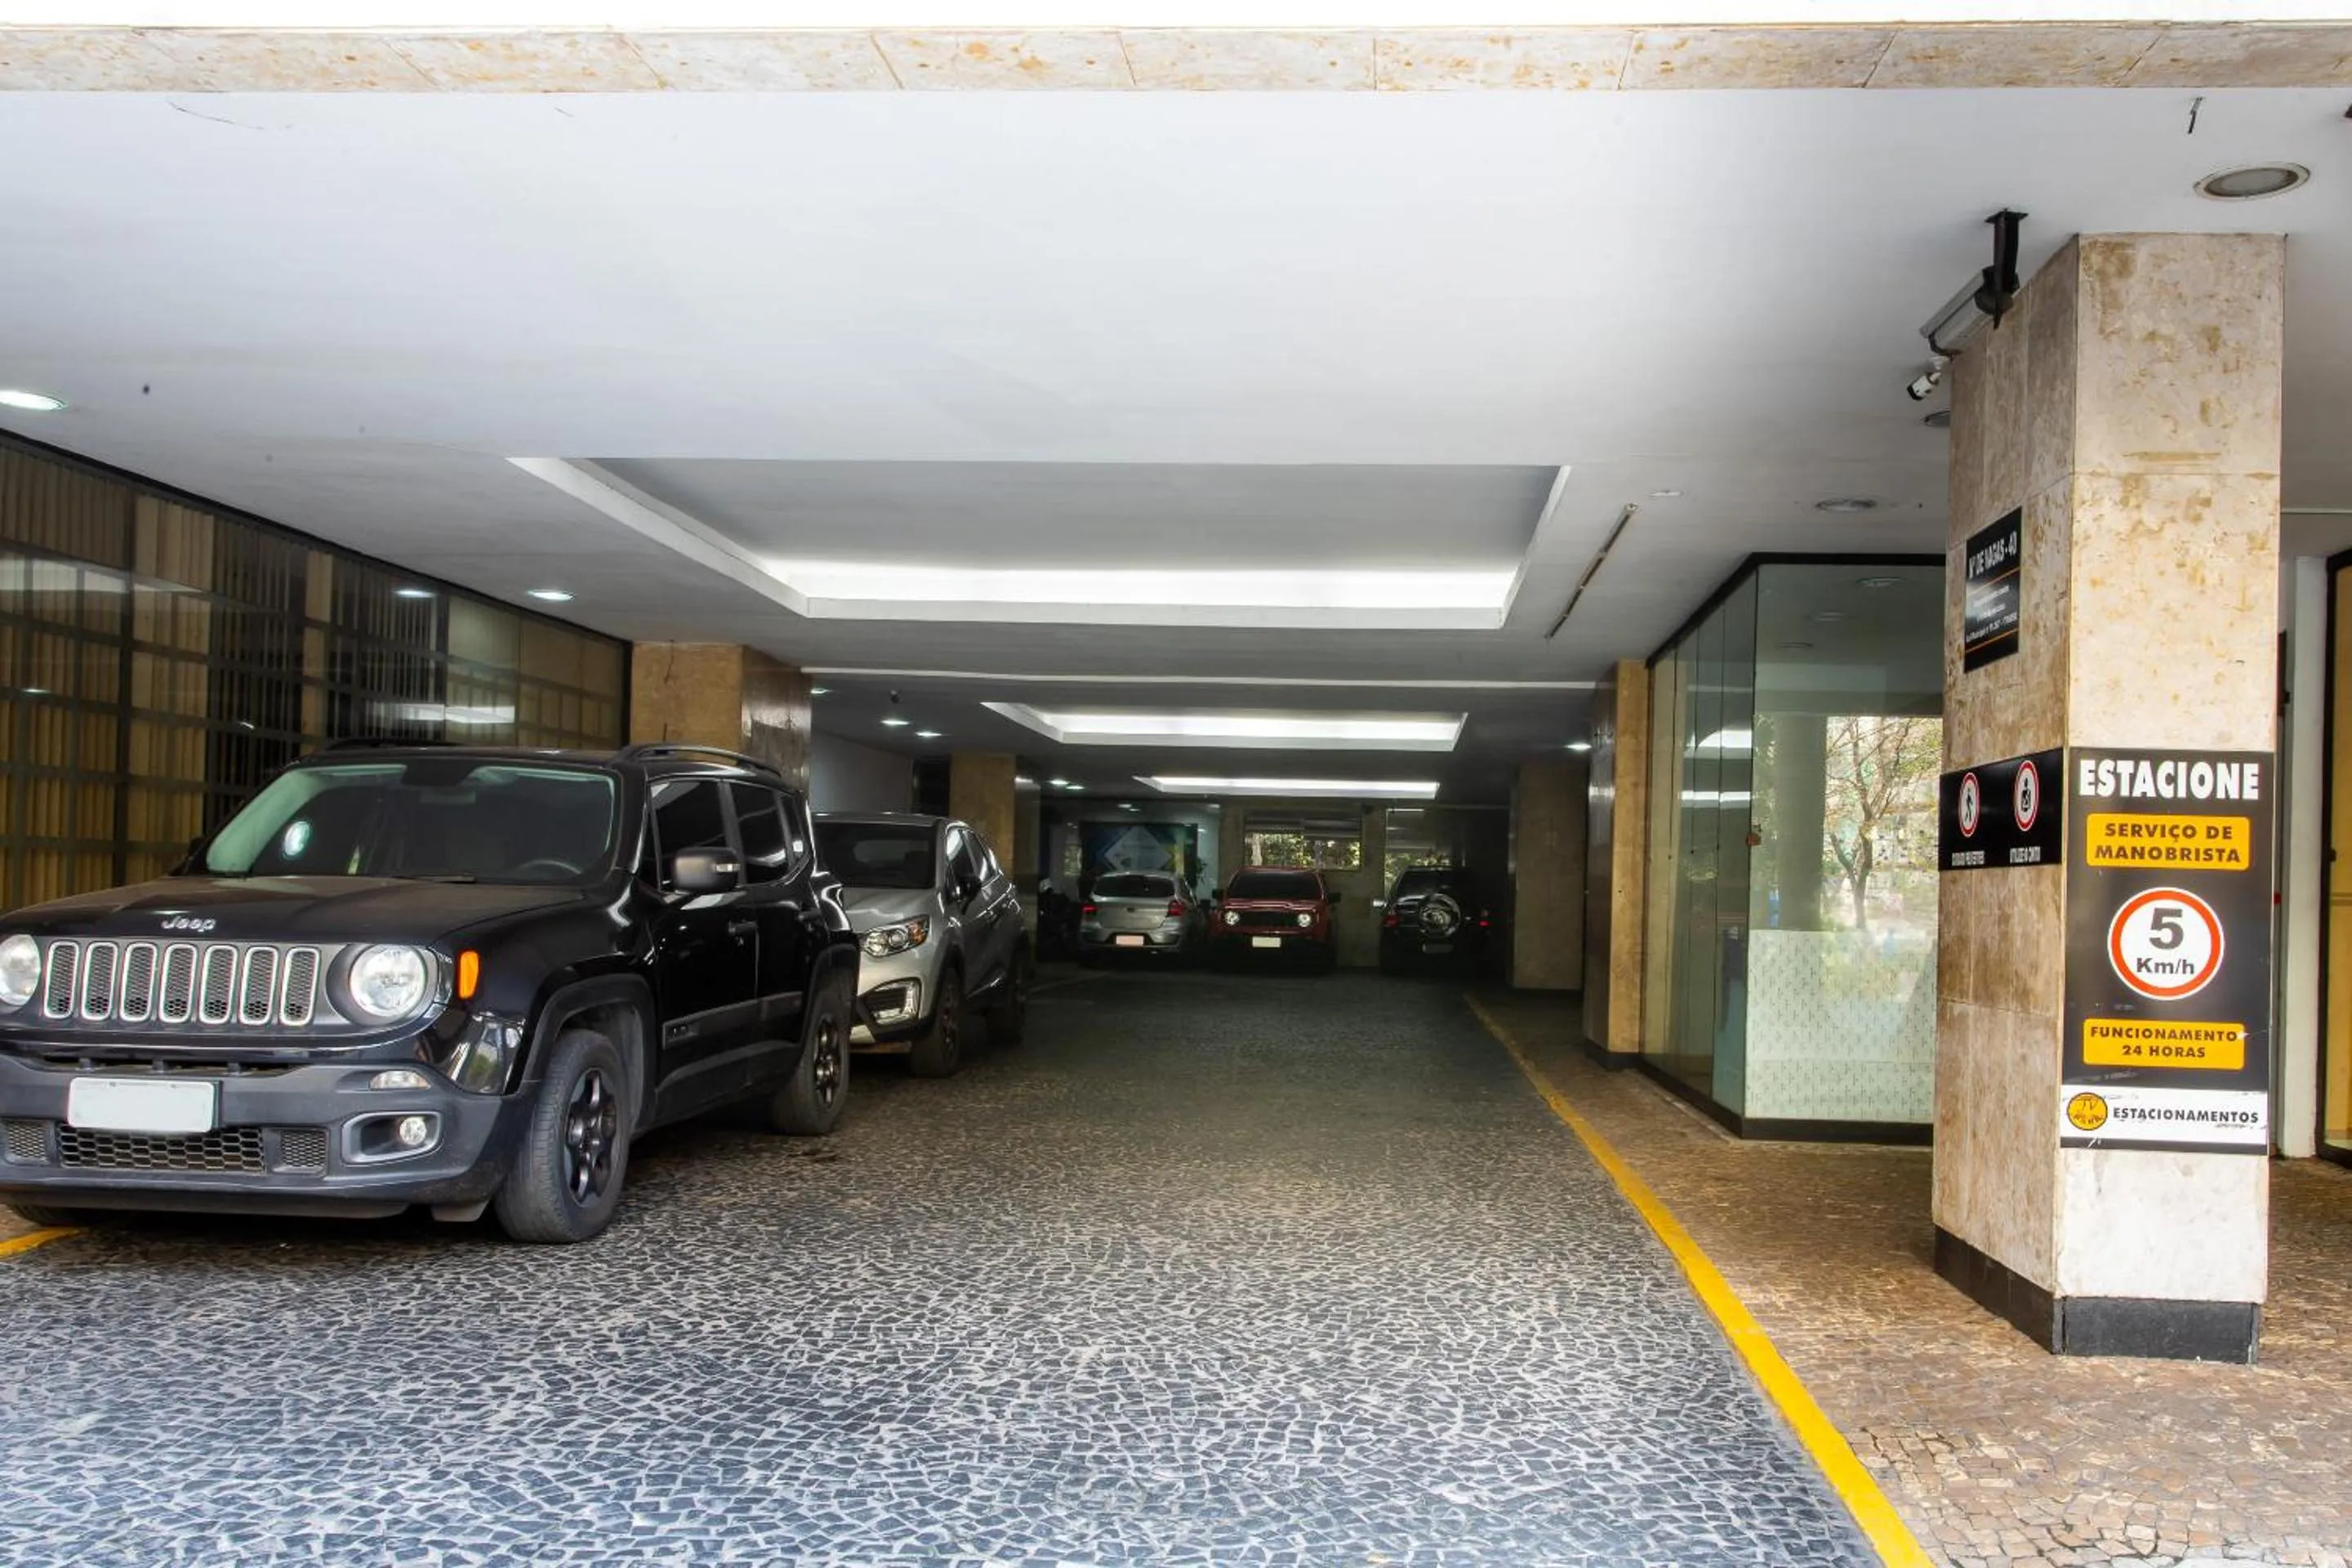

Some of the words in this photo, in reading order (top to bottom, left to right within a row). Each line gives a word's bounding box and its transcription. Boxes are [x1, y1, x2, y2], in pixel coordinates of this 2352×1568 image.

[2079, 758, 2260, 800] ESTACIONE
[2105, 822, 2197, 842] SERVIÇO
[2206, 826, 2233, 840] DE
[2094, 844, 2241, 863] MANOBRISTA
[161, 915, 216, 933] Jeep
[2149, 907, 2185, 951] 5
[2136, 957, 2194, 975] Km/h
[2090, 1027, 2238, 1042] FUNCIONAMENTO
[2123, 1045, 2142, 1057] 24
[2149, 1046, 2206, 1058] HORAS
[2113, 1107, 2259, 1124] ESTACIONAMENTOS
